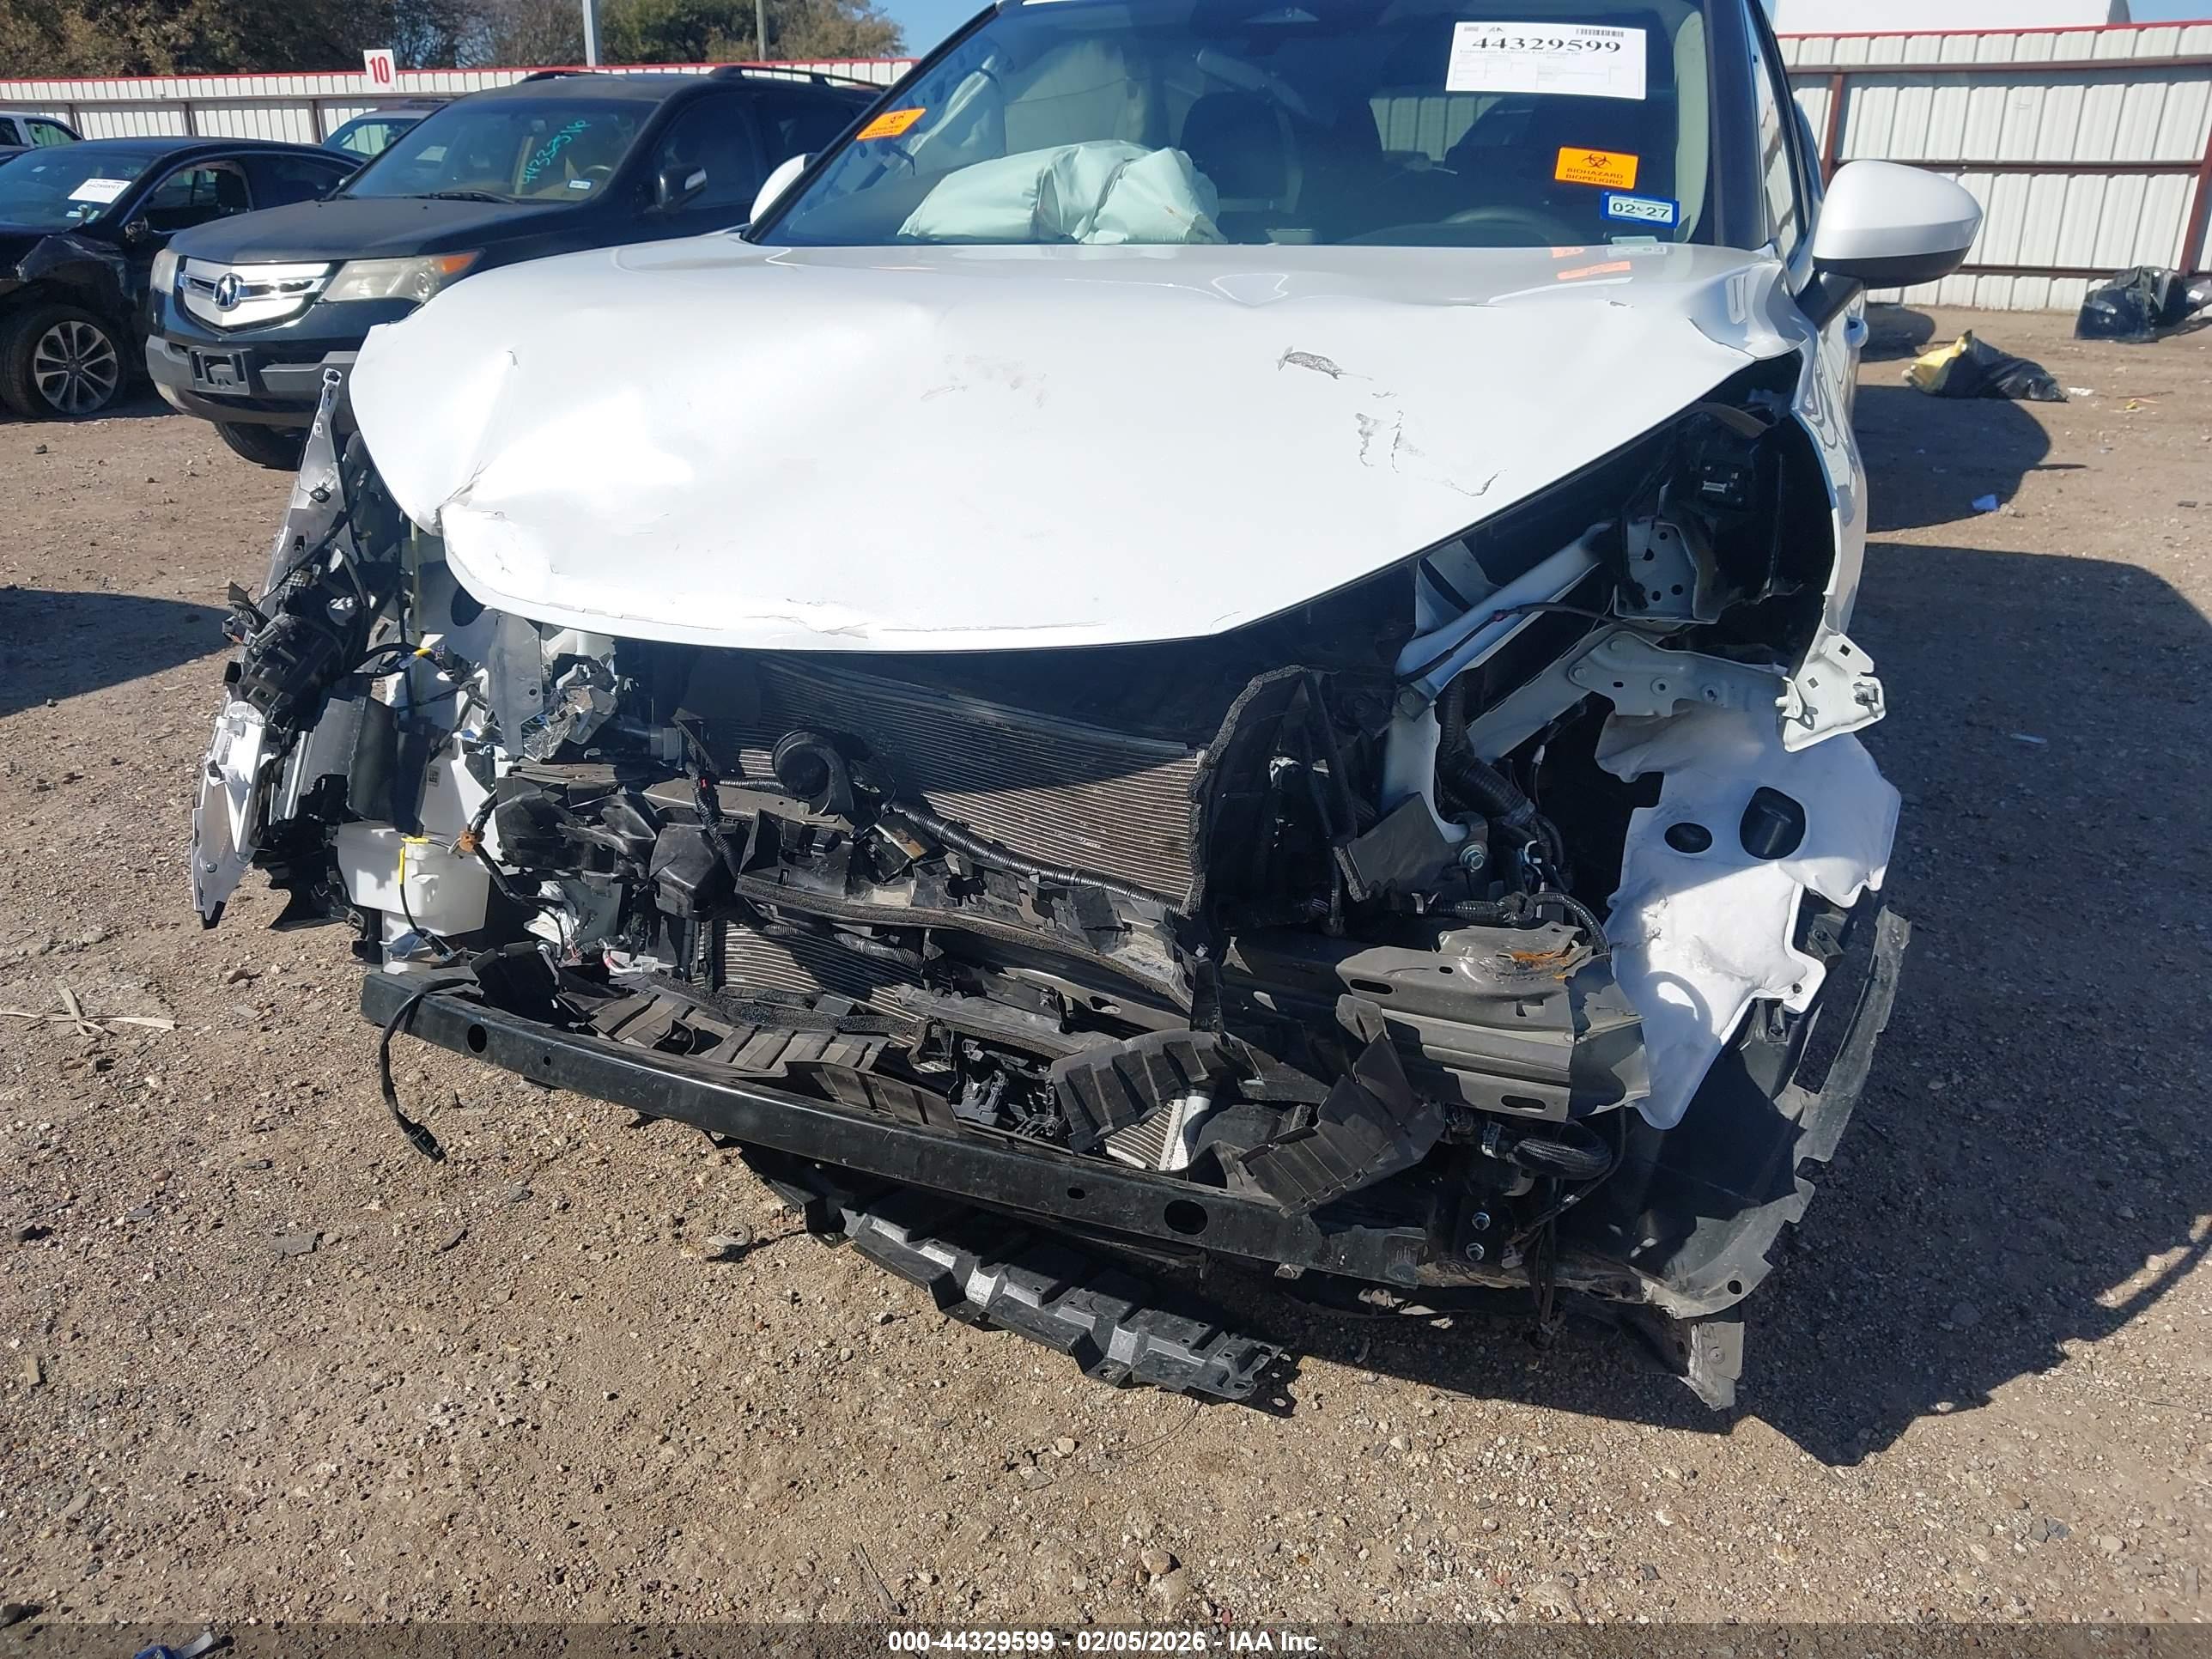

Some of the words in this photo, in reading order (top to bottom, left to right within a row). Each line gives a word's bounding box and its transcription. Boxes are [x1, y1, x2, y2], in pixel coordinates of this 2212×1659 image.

[1472, 37, 1621, 54] 44329599
[369, 56, 390, 83] 10
[1565, 173, 1624, 185] BIOPELIGRO
[1566, 167, 1624, 179] BIOHAZARD
[1612, 202, 1636, 215] 02
[1646, 206, 1670, 219] 27
